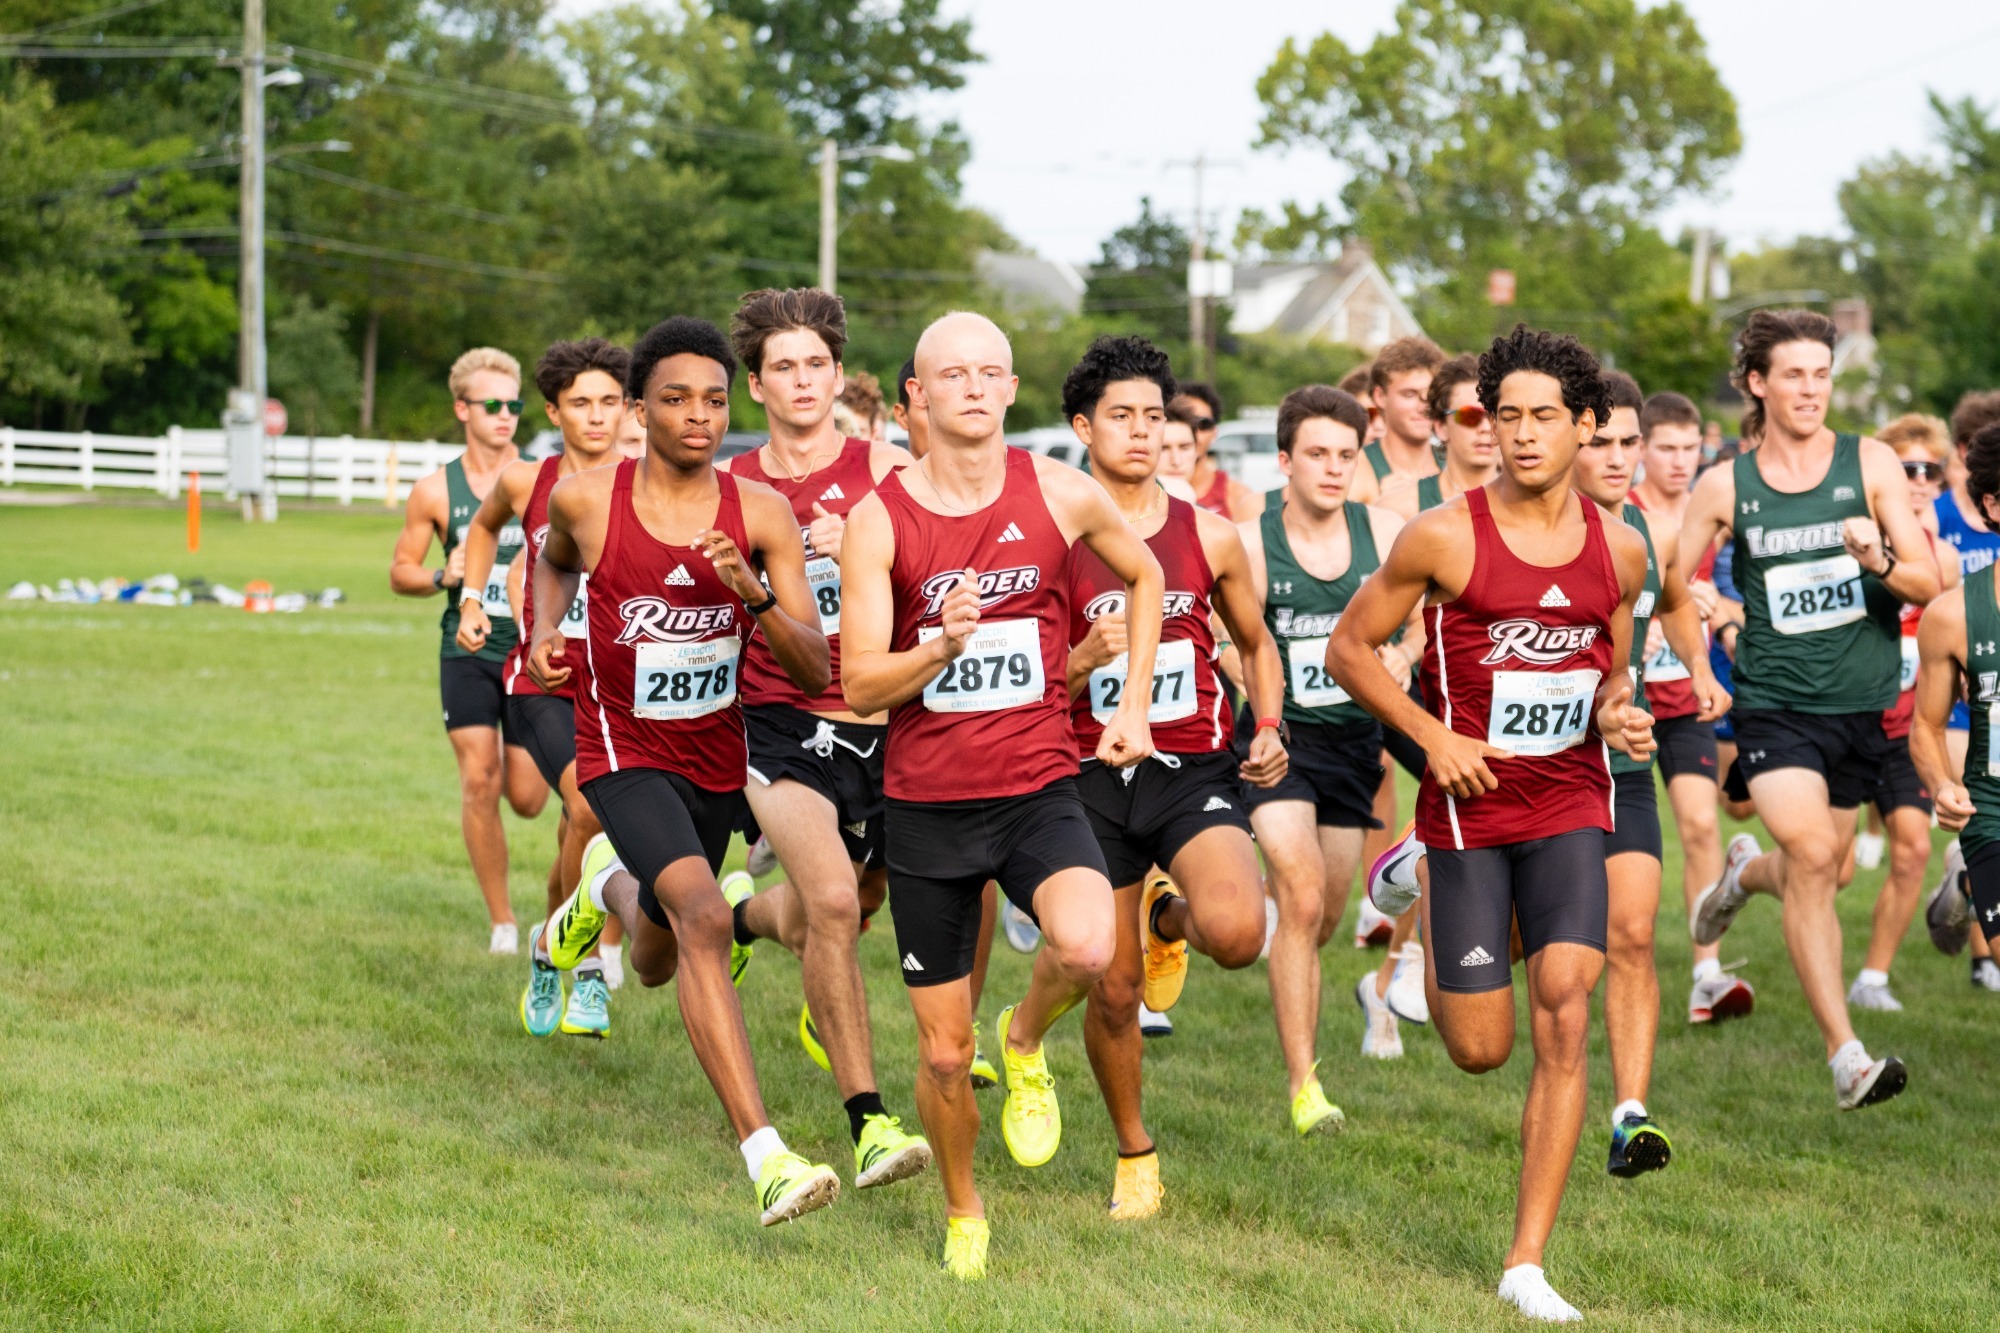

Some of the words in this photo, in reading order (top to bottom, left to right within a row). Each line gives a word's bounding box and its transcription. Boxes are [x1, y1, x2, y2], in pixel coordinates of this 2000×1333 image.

[806, 562, 833, 573] XICON
[664, 577, 695, 586] adidas
[808, 571, 835, 583] IMING
[917, 565, 1040, 621] RDER
[1540, 599, 1571, 608] adidas
[1779, 583, 1854, 618] 2829
[614, 596, 734, 643] RIDER
[977, 626, 1007, 638] XICON
[974, 639, 1007, 650] TIMING
[1479, 618, 1601, 665] RIDER
[678, 644, 716, 658] LEXICON
[688, 654, 717, 665] TIMING
[936, 653, 1031, 693] 2879
[647, 665, 729, 702] 2878
[1101, 671, 1184, 708] 277
[1502, 698, 1584, 736] 2874
[1460, 956, 1494, 967] adidas
